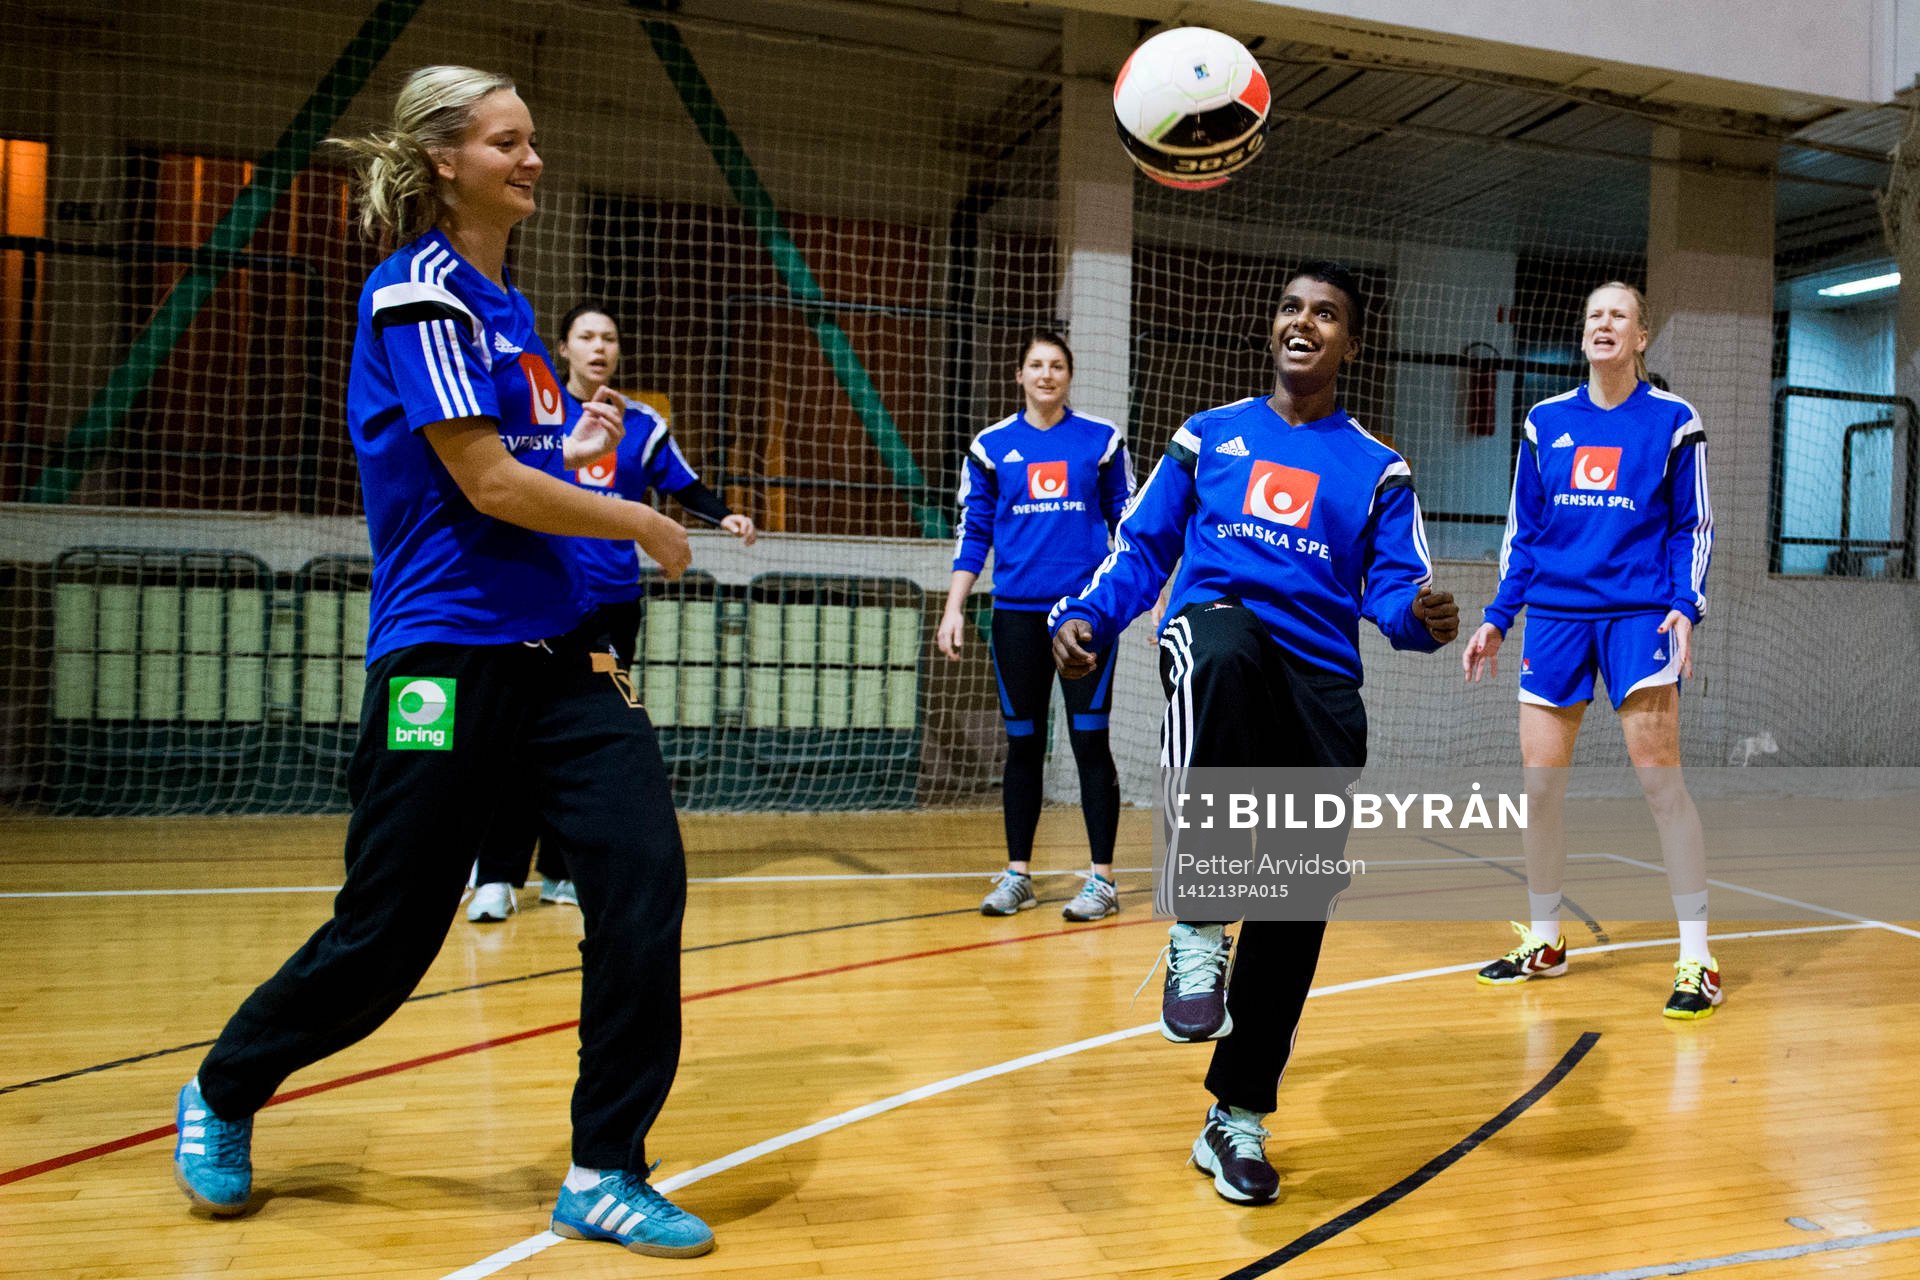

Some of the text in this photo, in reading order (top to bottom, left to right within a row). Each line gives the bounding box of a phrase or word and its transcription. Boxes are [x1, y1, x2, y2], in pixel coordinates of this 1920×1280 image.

[1012, 502, 1060, 515] SVENSKA
[1607, 496, 1636, 511] SPEL
[1216, 523, 1290, 549] SVENSKA
[396, 727, 445, 746] bring
